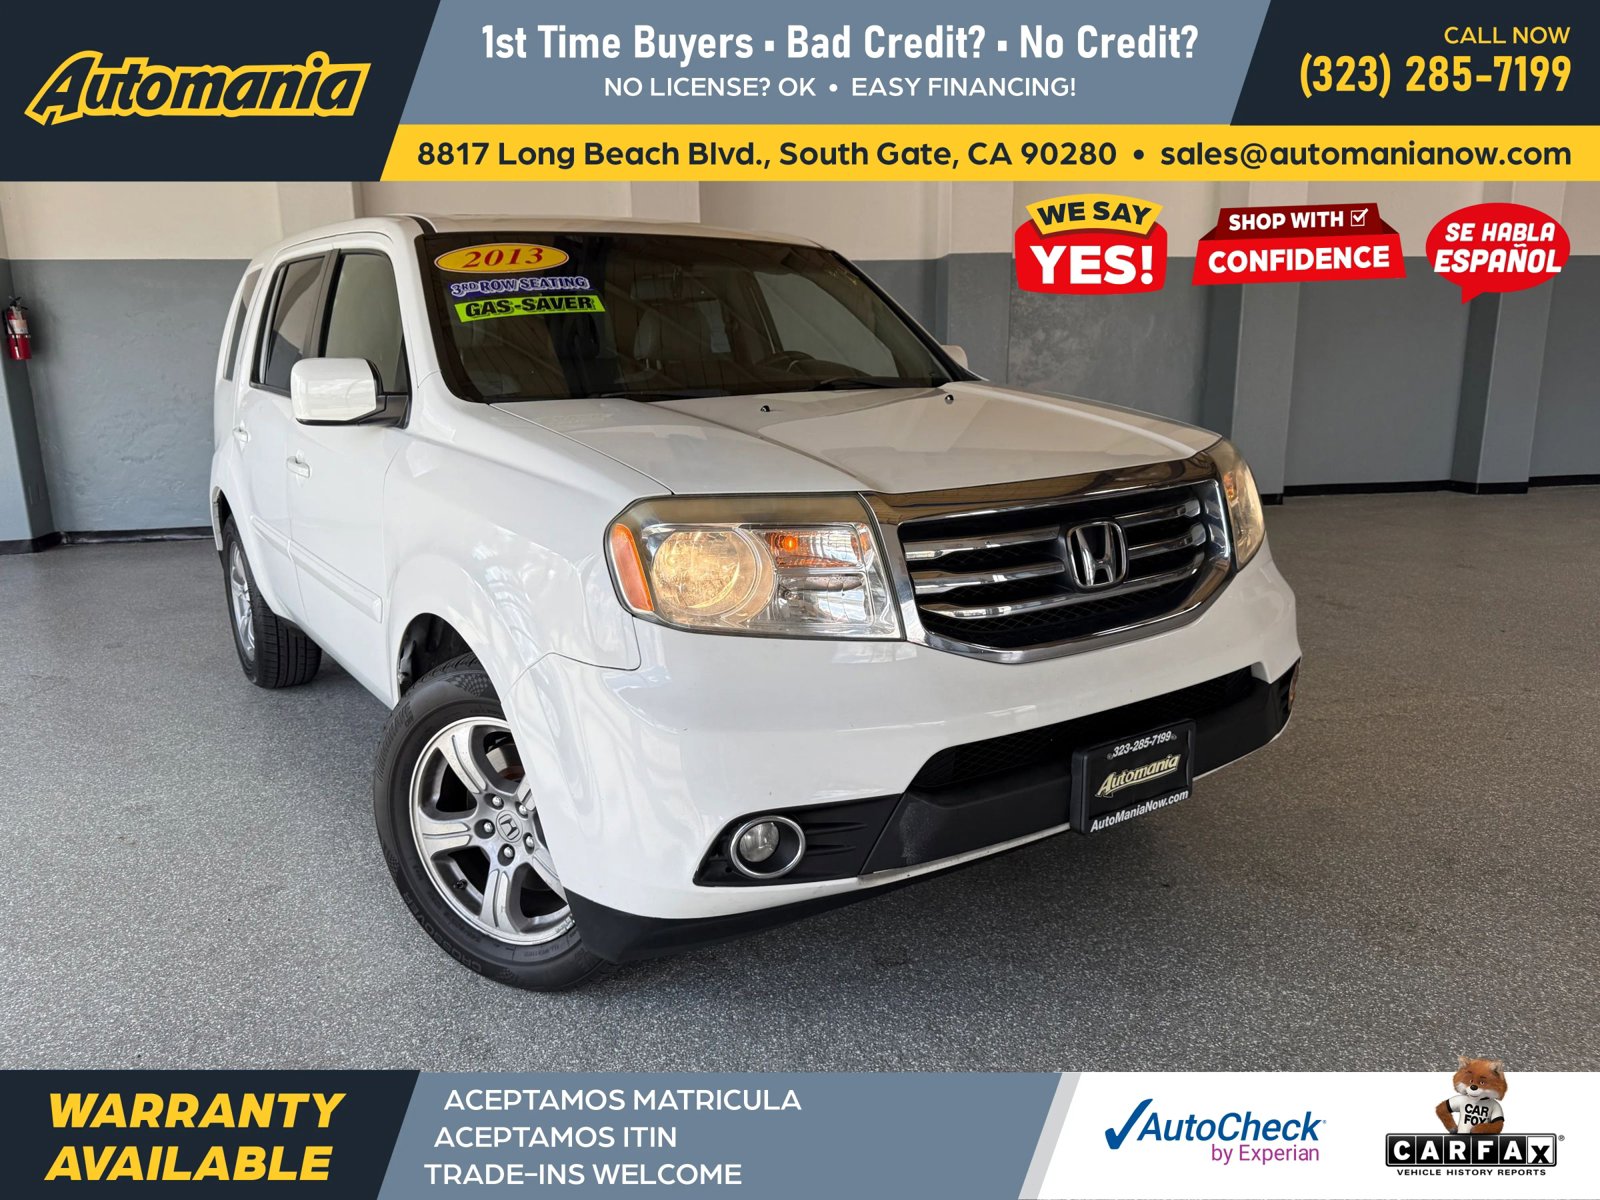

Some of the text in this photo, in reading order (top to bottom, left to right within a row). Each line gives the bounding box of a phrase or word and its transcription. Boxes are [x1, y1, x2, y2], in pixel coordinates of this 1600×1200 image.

[462, 247, 543, 269] 2013
[451, 276, 591, 298] 3RD ROW SEATING
[465, 297, 595, 319] GAS-SAVER
[1112, 730, 1172, 758] 323-285-7199
[1095, 754, 1181, 798] Automania
[1090, 790, 1189, 832] AutoManiaNow.com
